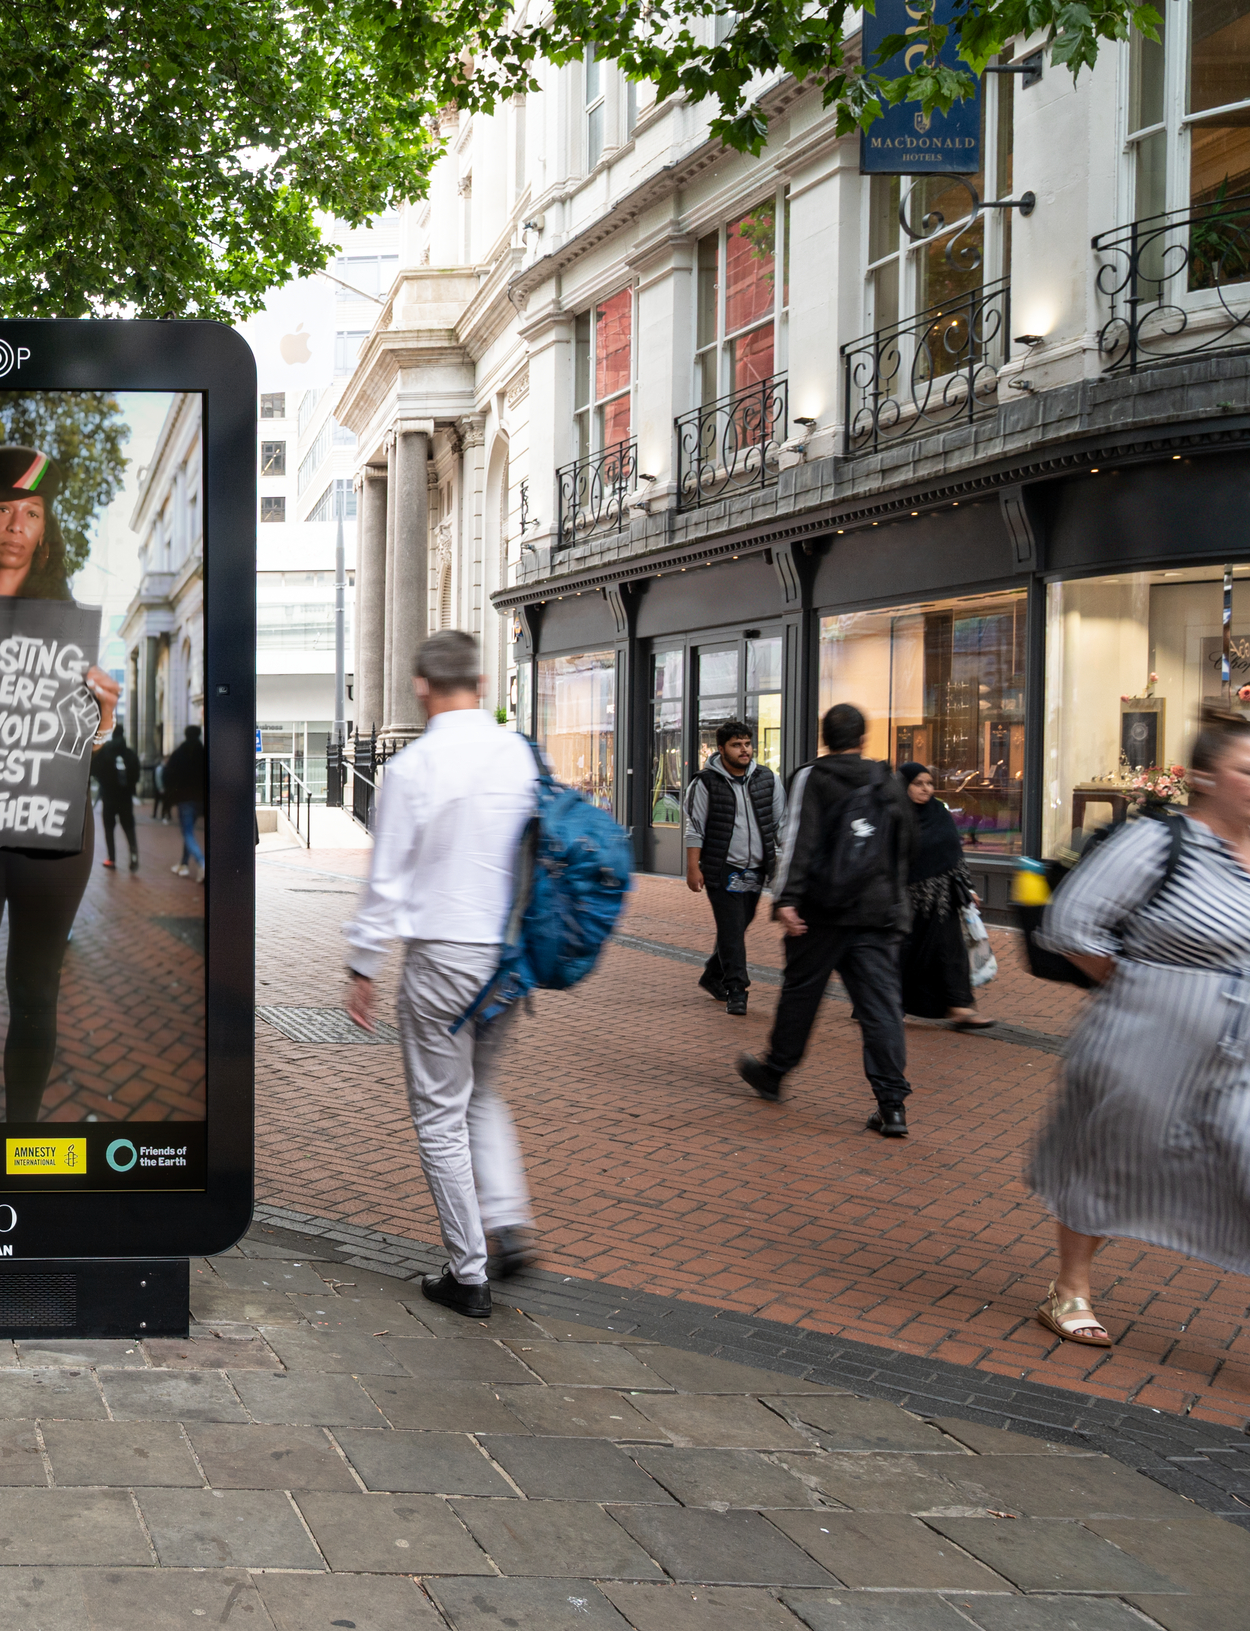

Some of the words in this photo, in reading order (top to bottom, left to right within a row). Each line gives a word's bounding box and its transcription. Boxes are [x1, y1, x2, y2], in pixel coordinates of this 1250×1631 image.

[870, 137, 975, 149] MACDONALD
[902, 153, 942, 161] HOTELS
[14, 1147, 56, 1158] AMNESTY
[140, 1146, 175, 1156] Friends
[176, 1146, 187, 1156] of
[140, 1157, 157, 1166] the
[158, 1157, 186, 1166] Earth
